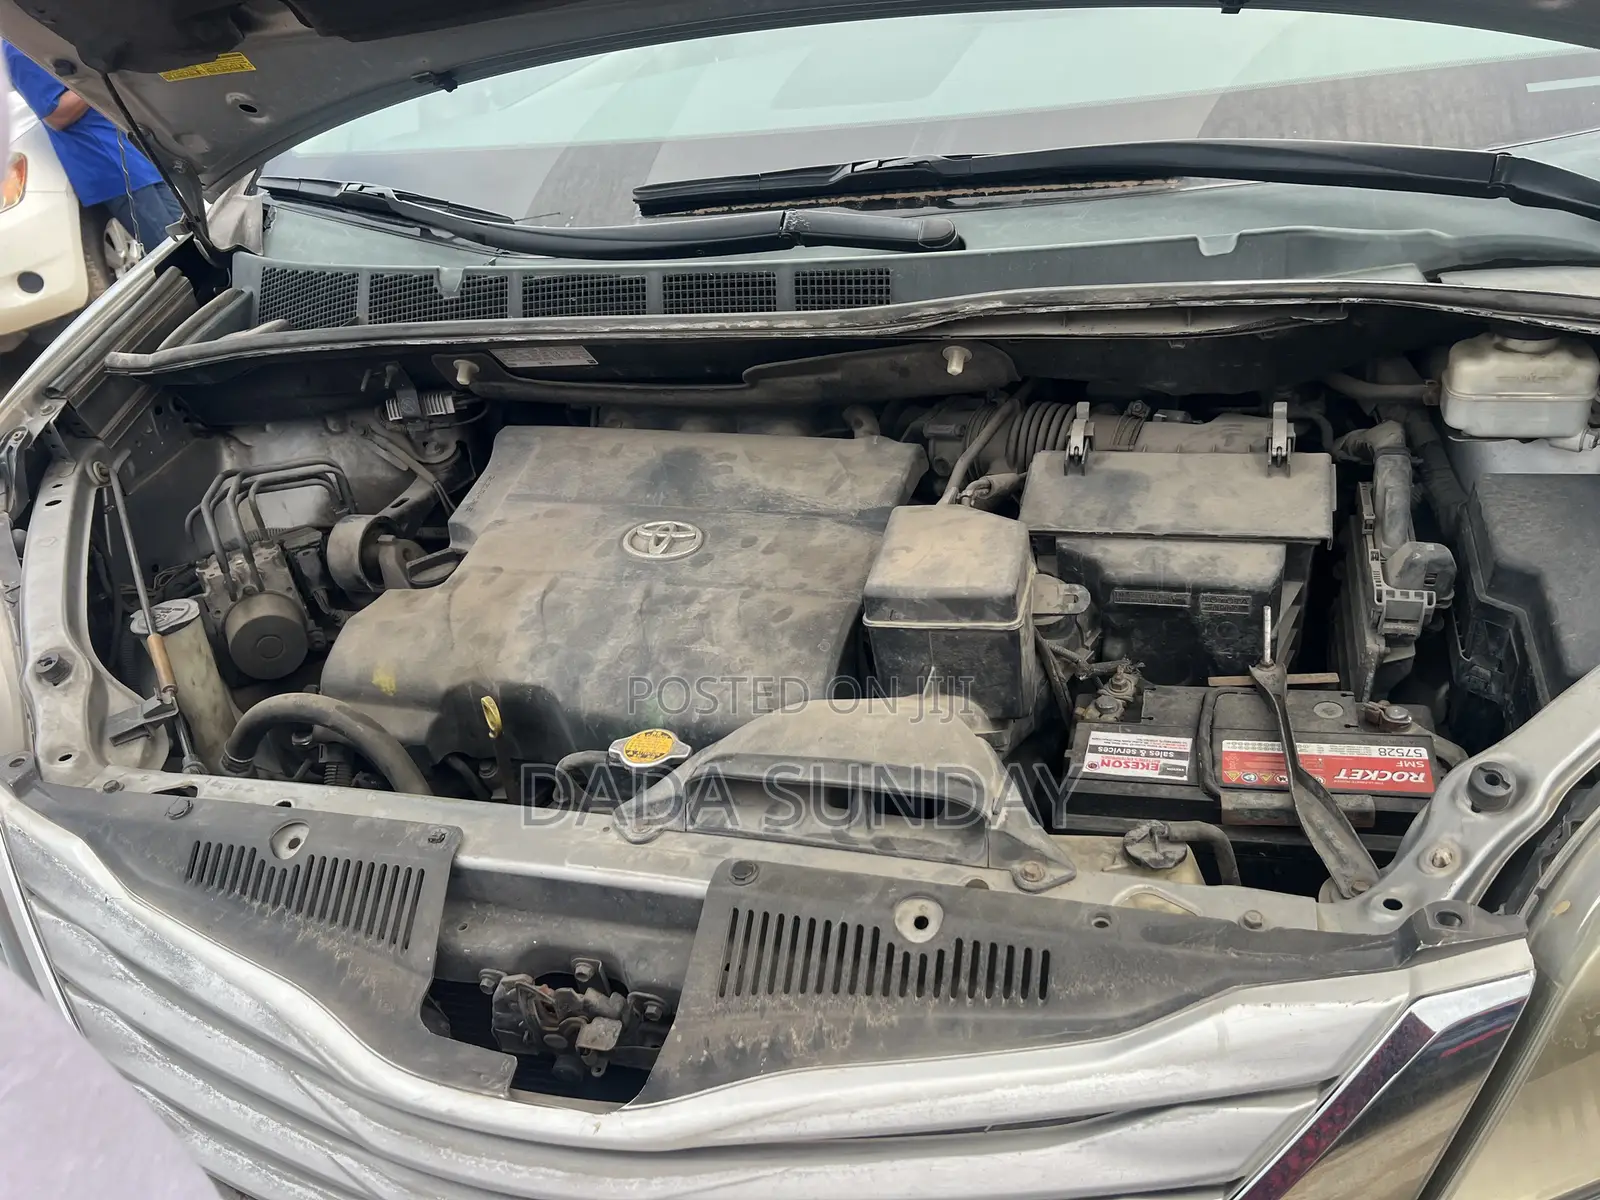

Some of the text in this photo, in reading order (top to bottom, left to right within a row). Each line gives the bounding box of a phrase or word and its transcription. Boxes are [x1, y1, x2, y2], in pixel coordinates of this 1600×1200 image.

[1098, 746, 1174, 758] sales & services
[1378, 747, 1422, 758] 57528
[1100, 759, 1159, 771] EKESON
[1396, 760, 1424, 768] SMF
[1334, 768, 1425, 783] ROCKET
